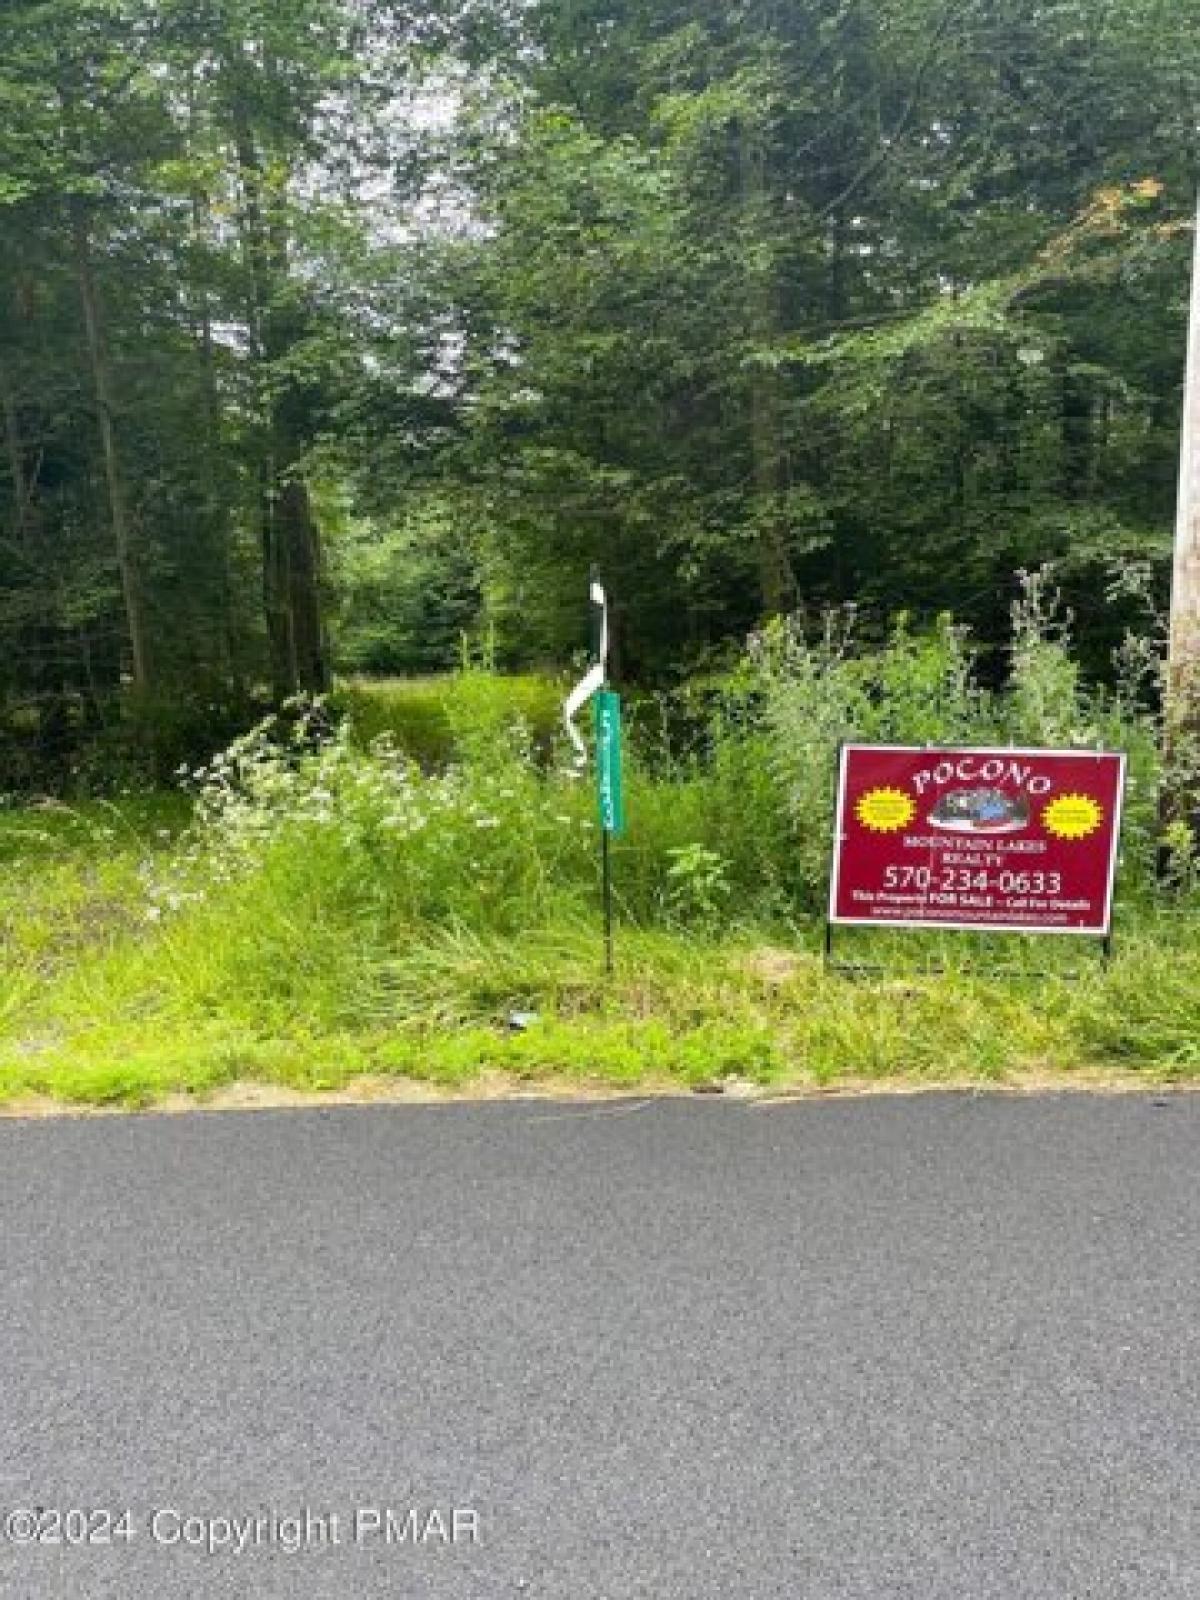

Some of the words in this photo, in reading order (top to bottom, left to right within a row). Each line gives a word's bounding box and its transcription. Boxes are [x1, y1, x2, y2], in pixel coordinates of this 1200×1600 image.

[912, 759, 1051, 795] POCONO
[882, 865, 1060, 894] 570-234-0633
[929, 892, 957, 904] FOR
[959, 894, 993, 907] SALE
